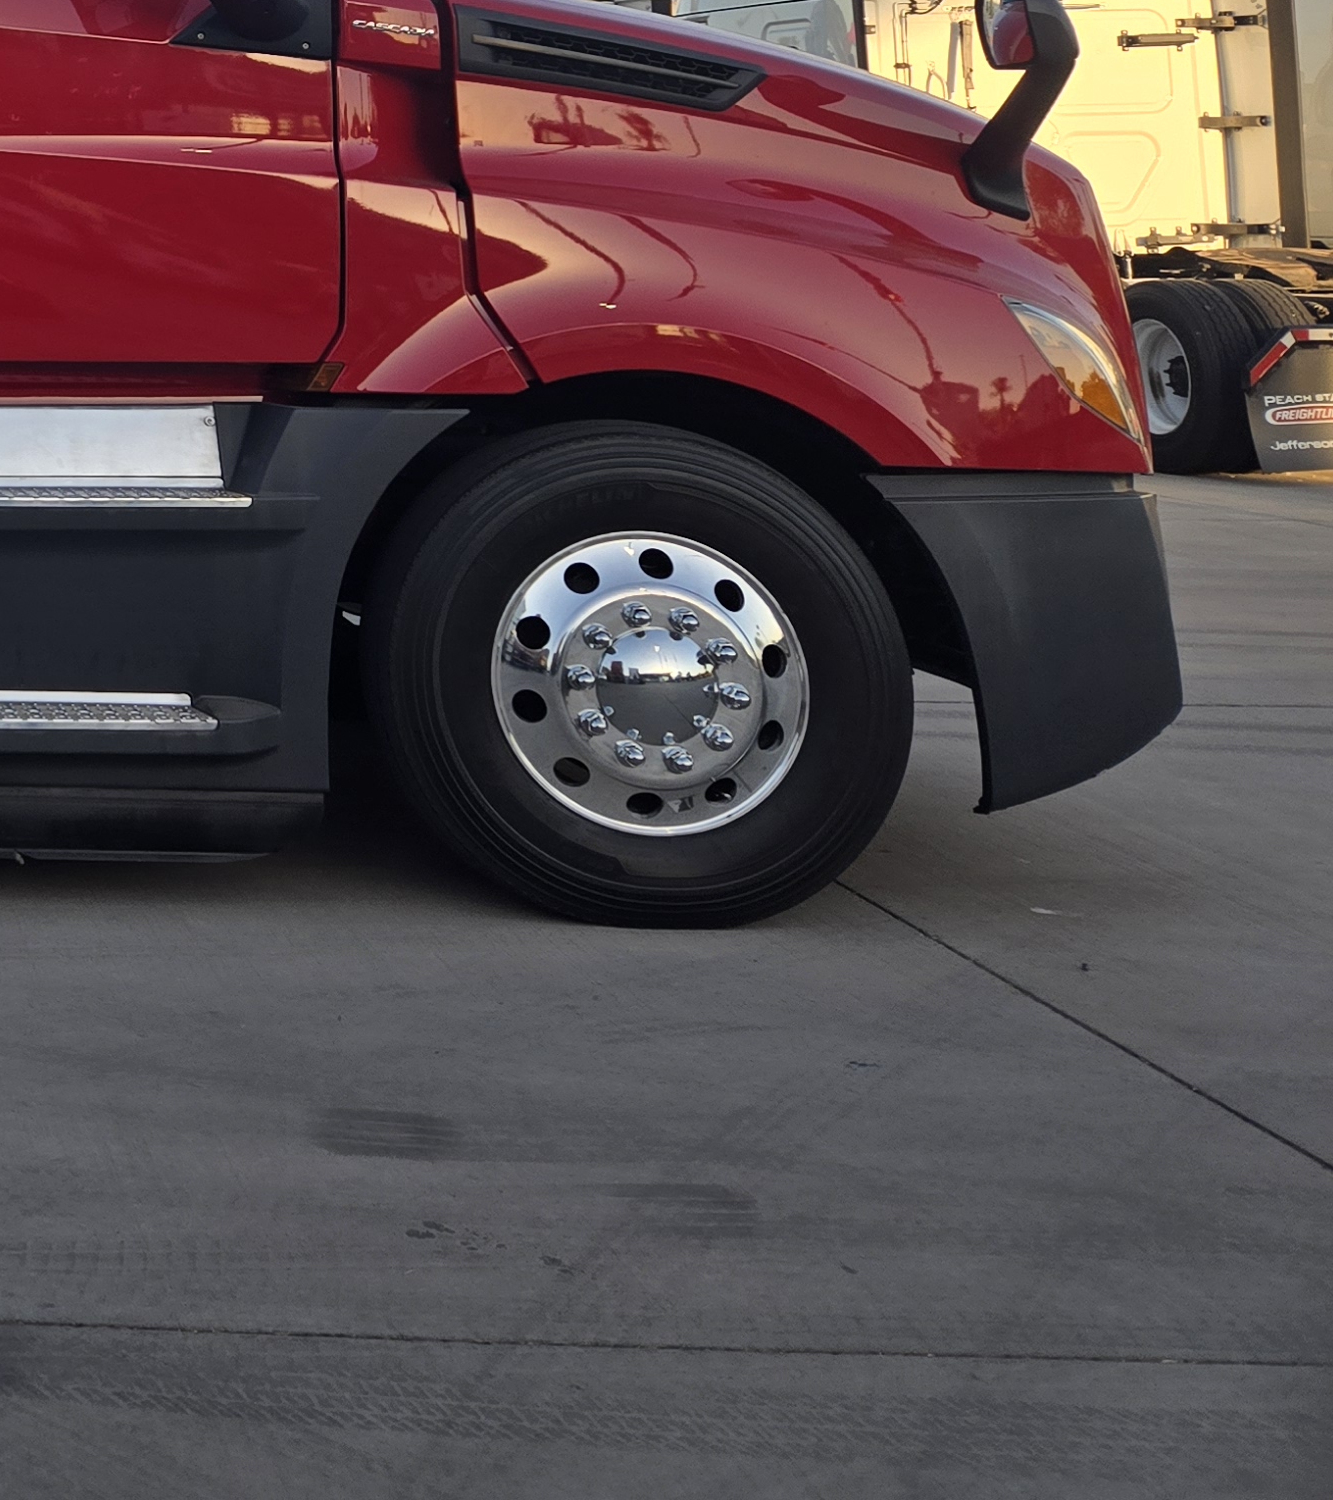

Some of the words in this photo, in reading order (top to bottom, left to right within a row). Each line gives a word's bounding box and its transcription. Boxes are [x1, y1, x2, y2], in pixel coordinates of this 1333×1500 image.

[352, 19, 435, 36] CASCADIA
[1264, 395, 1312, 406] PEACH
[1276, 409, 1333, 420] FREIGHTLI
